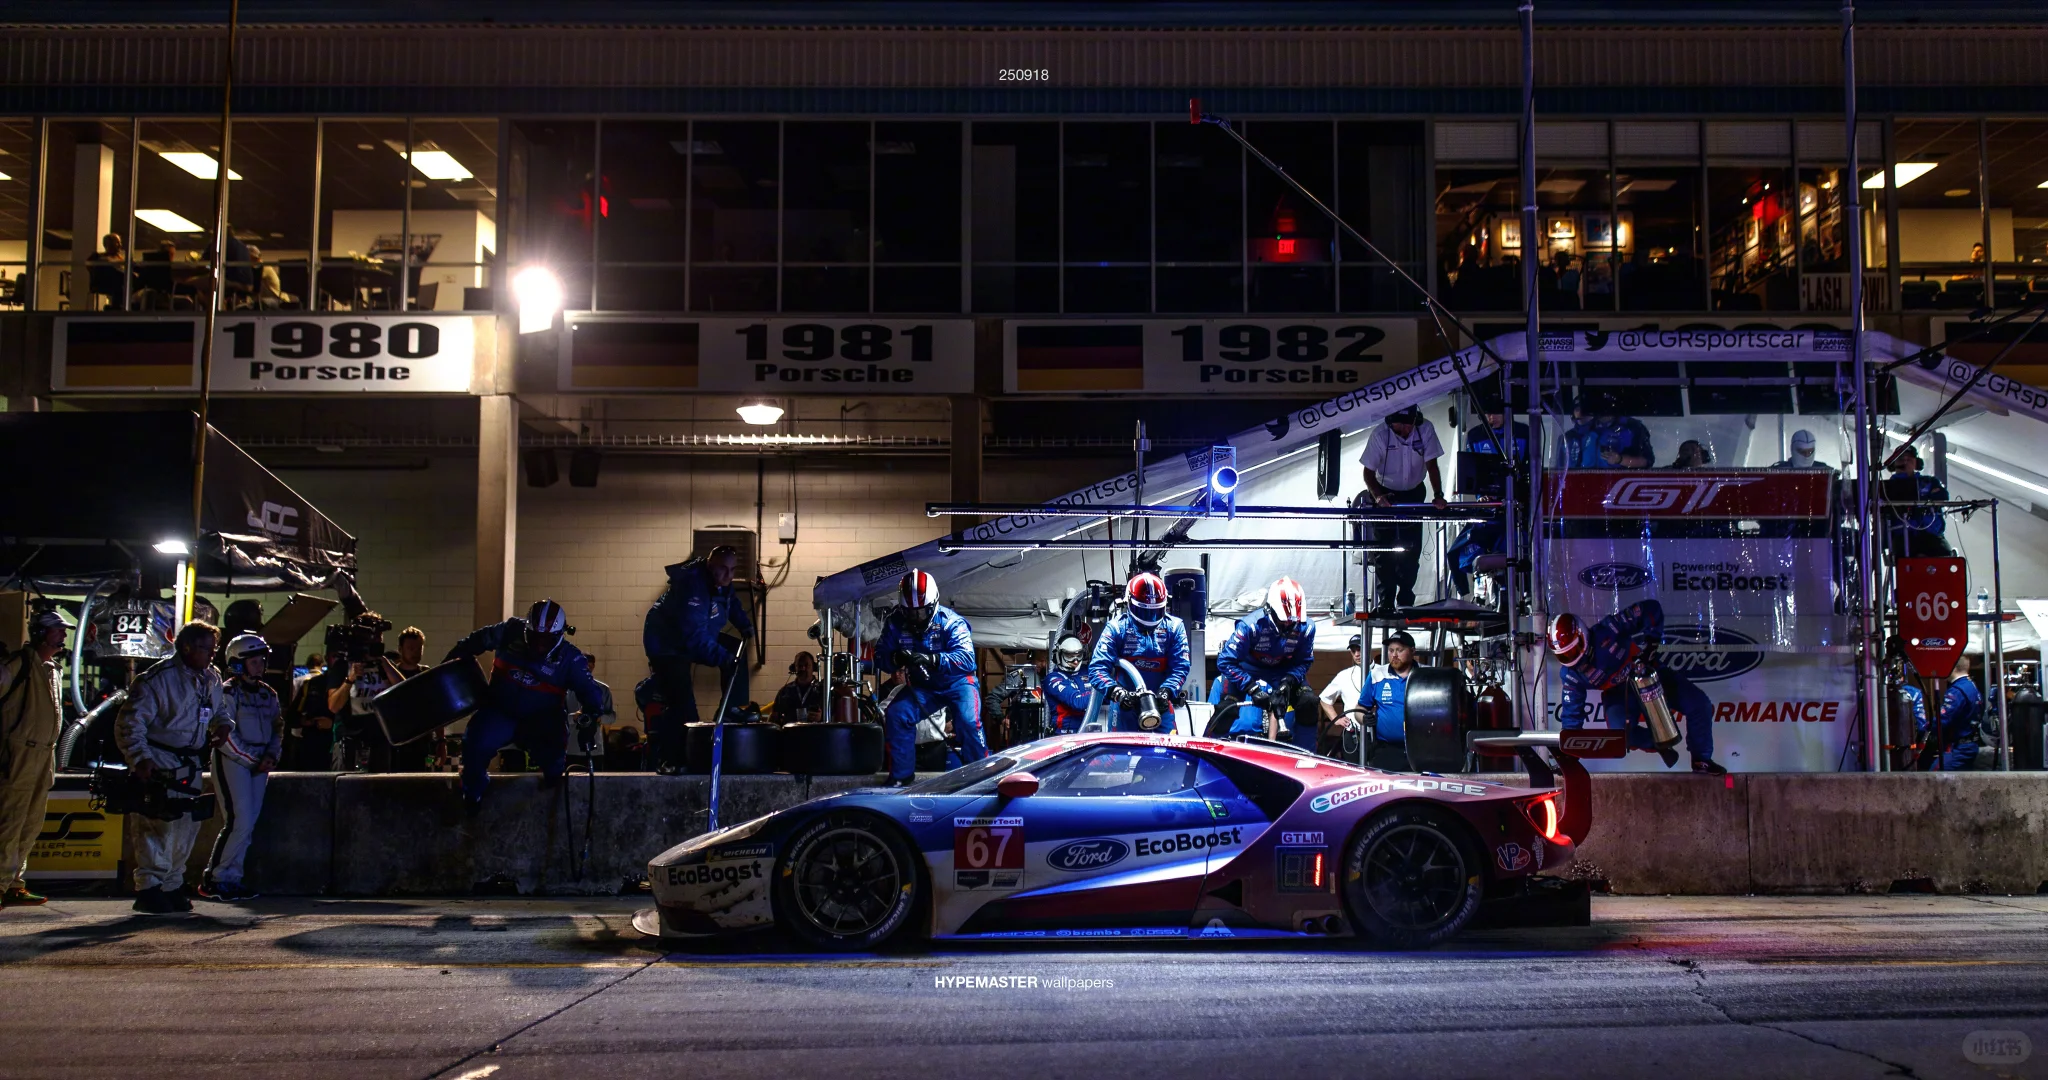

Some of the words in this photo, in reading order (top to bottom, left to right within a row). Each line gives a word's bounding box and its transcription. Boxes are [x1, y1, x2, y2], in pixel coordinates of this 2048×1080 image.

[223, 322, 440, 359] 1980
[735, 323, 933, 361] 1981
[1171, 324, 1386, 362] 1982
[1618, 330, 1805, 352] @CGRsportscar
[250, 361, 410, 380] Porsche
[755, 364, 914, 383] Porsche
[1200, 364, 1359, 384] Porsche
[1298, 350, 1472, 429] @CGRsportscar
[1601, 477, 1765, 514] GT
[1594, 564, 1637, 586] Ford
[1672, 562, 1723, 572] Powered
[1726, 562, 1740, 574] by
[1672, 573, 1789, 592] EcoBoost
[1916, 592, 1950, 621] 66
[117, 615, 143, 632] 84
[1563, 736, 1623, 752] GT
[1330, 784, 1384, 806] Castrol
[966, 828, 1013, 868] 67
[1135, 827, 1242, 857] EcoBoost
[1283, 832, 1321, 844] GTLM
[723, 846, 767, 857] MICHELIN
[1063, 841, 1113, 868] Ford
[668, 860, 763, 886] EcoBoost
